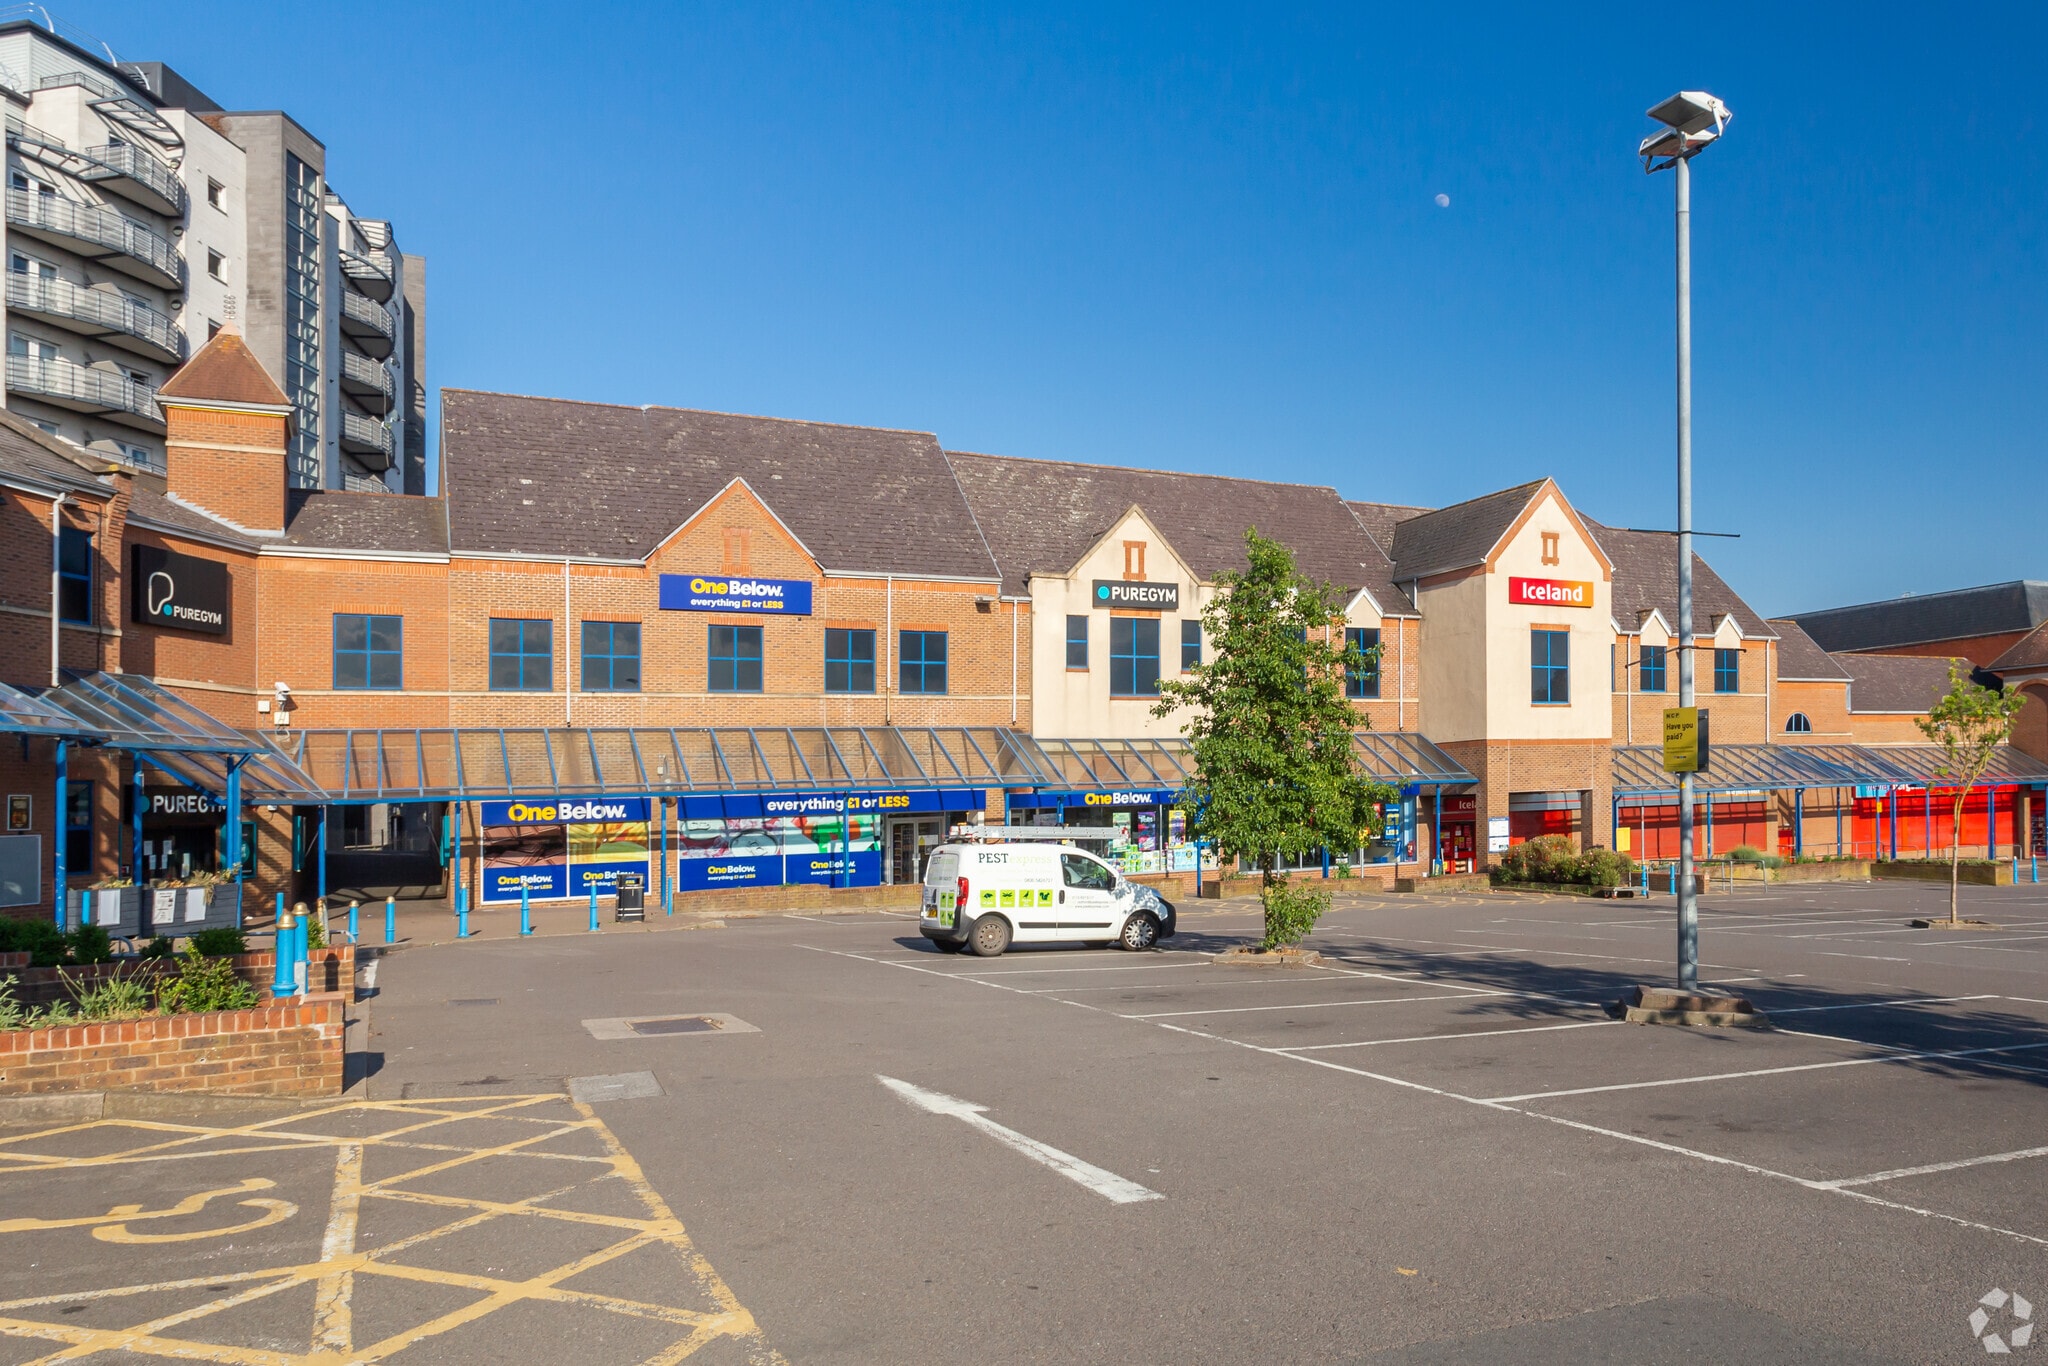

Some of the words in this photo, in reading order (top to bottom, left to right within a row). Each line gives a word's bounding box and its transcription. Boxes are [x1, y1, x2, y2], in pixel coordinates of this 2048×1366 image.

[690, 578, 728, 594] One
[1111, 586, 1176, 603] PUREGYM
[1522, 582, 1583, 602] Iceland
[690, 598, 740, 609] everything
[741, 599, 751, 608] £1
[752, 600, 762, 608] or
[762, 600, 784, 609] LESS
[173, 605, 222, 625] PUREGYM
[1681, 723, 1693, 731] you
[1666, 732, 1683, 742] paid?
[767, 797, 844, 813] everything
[847, 796, 860, 808] £1
[862, 797, 877, 807] or
[878, 795, 910, 808] LESS
[1084, 793, 1113, 805] One
[1459, 800, 1476, 810] Icel
[508, 803, 557, 822] One
[978, 852, 1009, 864] PEST
[707, 865, 727, 874] One
[810, 861, 829, 869] One
[497, 876, 520, 885] One
[583, 871, 604, 881] One
